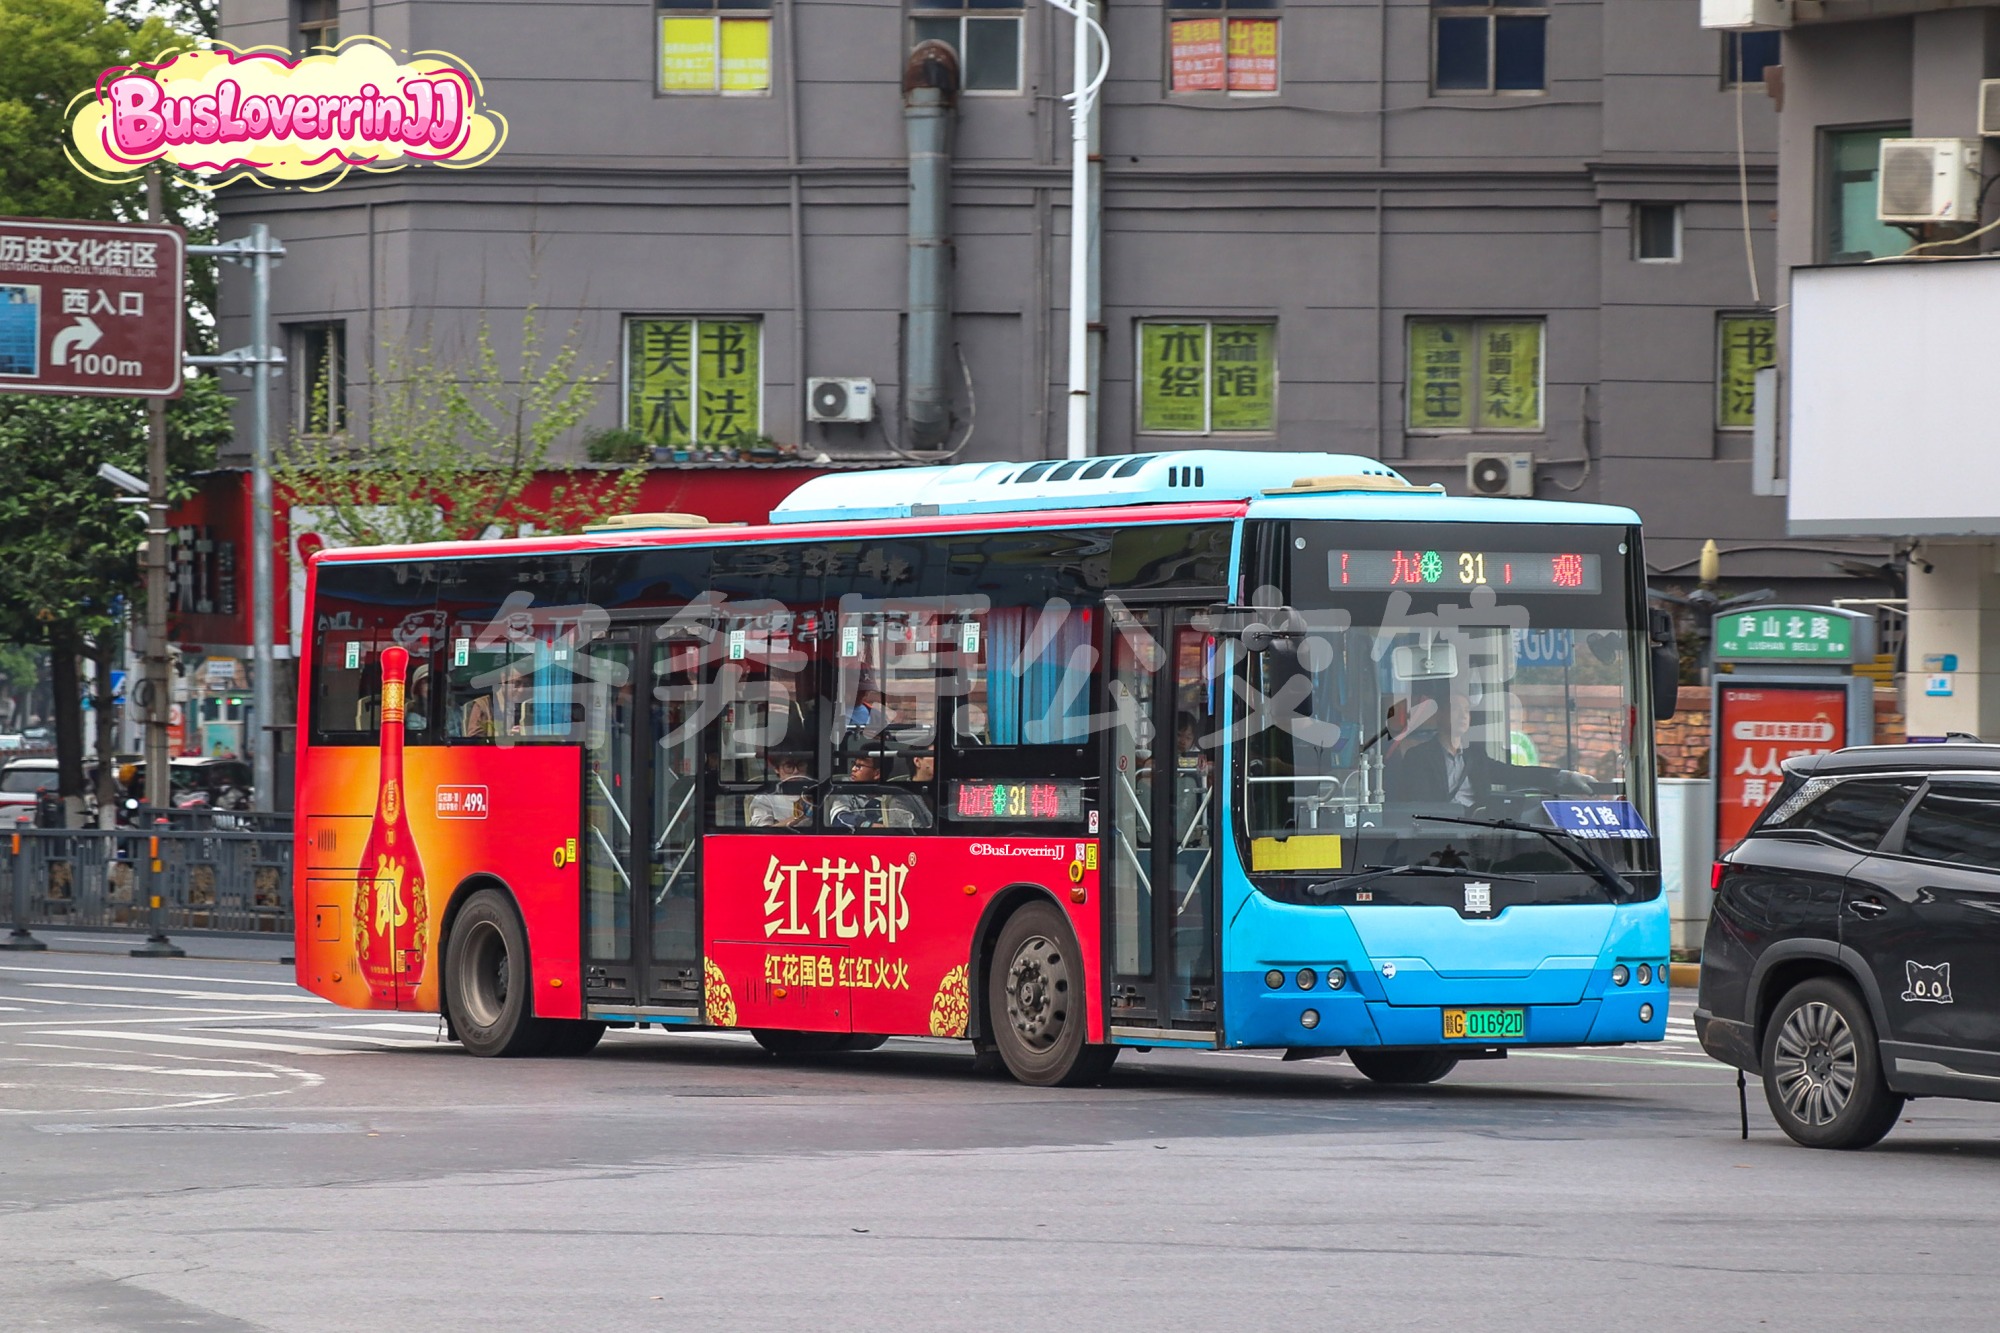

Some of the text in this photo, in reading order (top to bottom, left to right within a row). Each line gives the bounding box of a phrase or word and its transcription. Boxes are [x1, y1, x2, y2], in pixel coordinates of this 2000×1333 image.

[1228, 21, 1276, 55] 出租
[0, 236, 158, 269] 历史文化街区
[62, 288, 144, 316] 西入口
[69, 354, 142, 376] 100m
[701, 324, 747, 441] 书法
[1459, 553, 1487, 584] 31
[1737, 615, 1831, 640] 庐山北路
[1009, 786, 1027, 815] 31
[1571, 806, 1620, 826] 31路
[763, 854, 910, 943] 红花郎
[764, 953, 909, 990] 红花国色 红红火火
